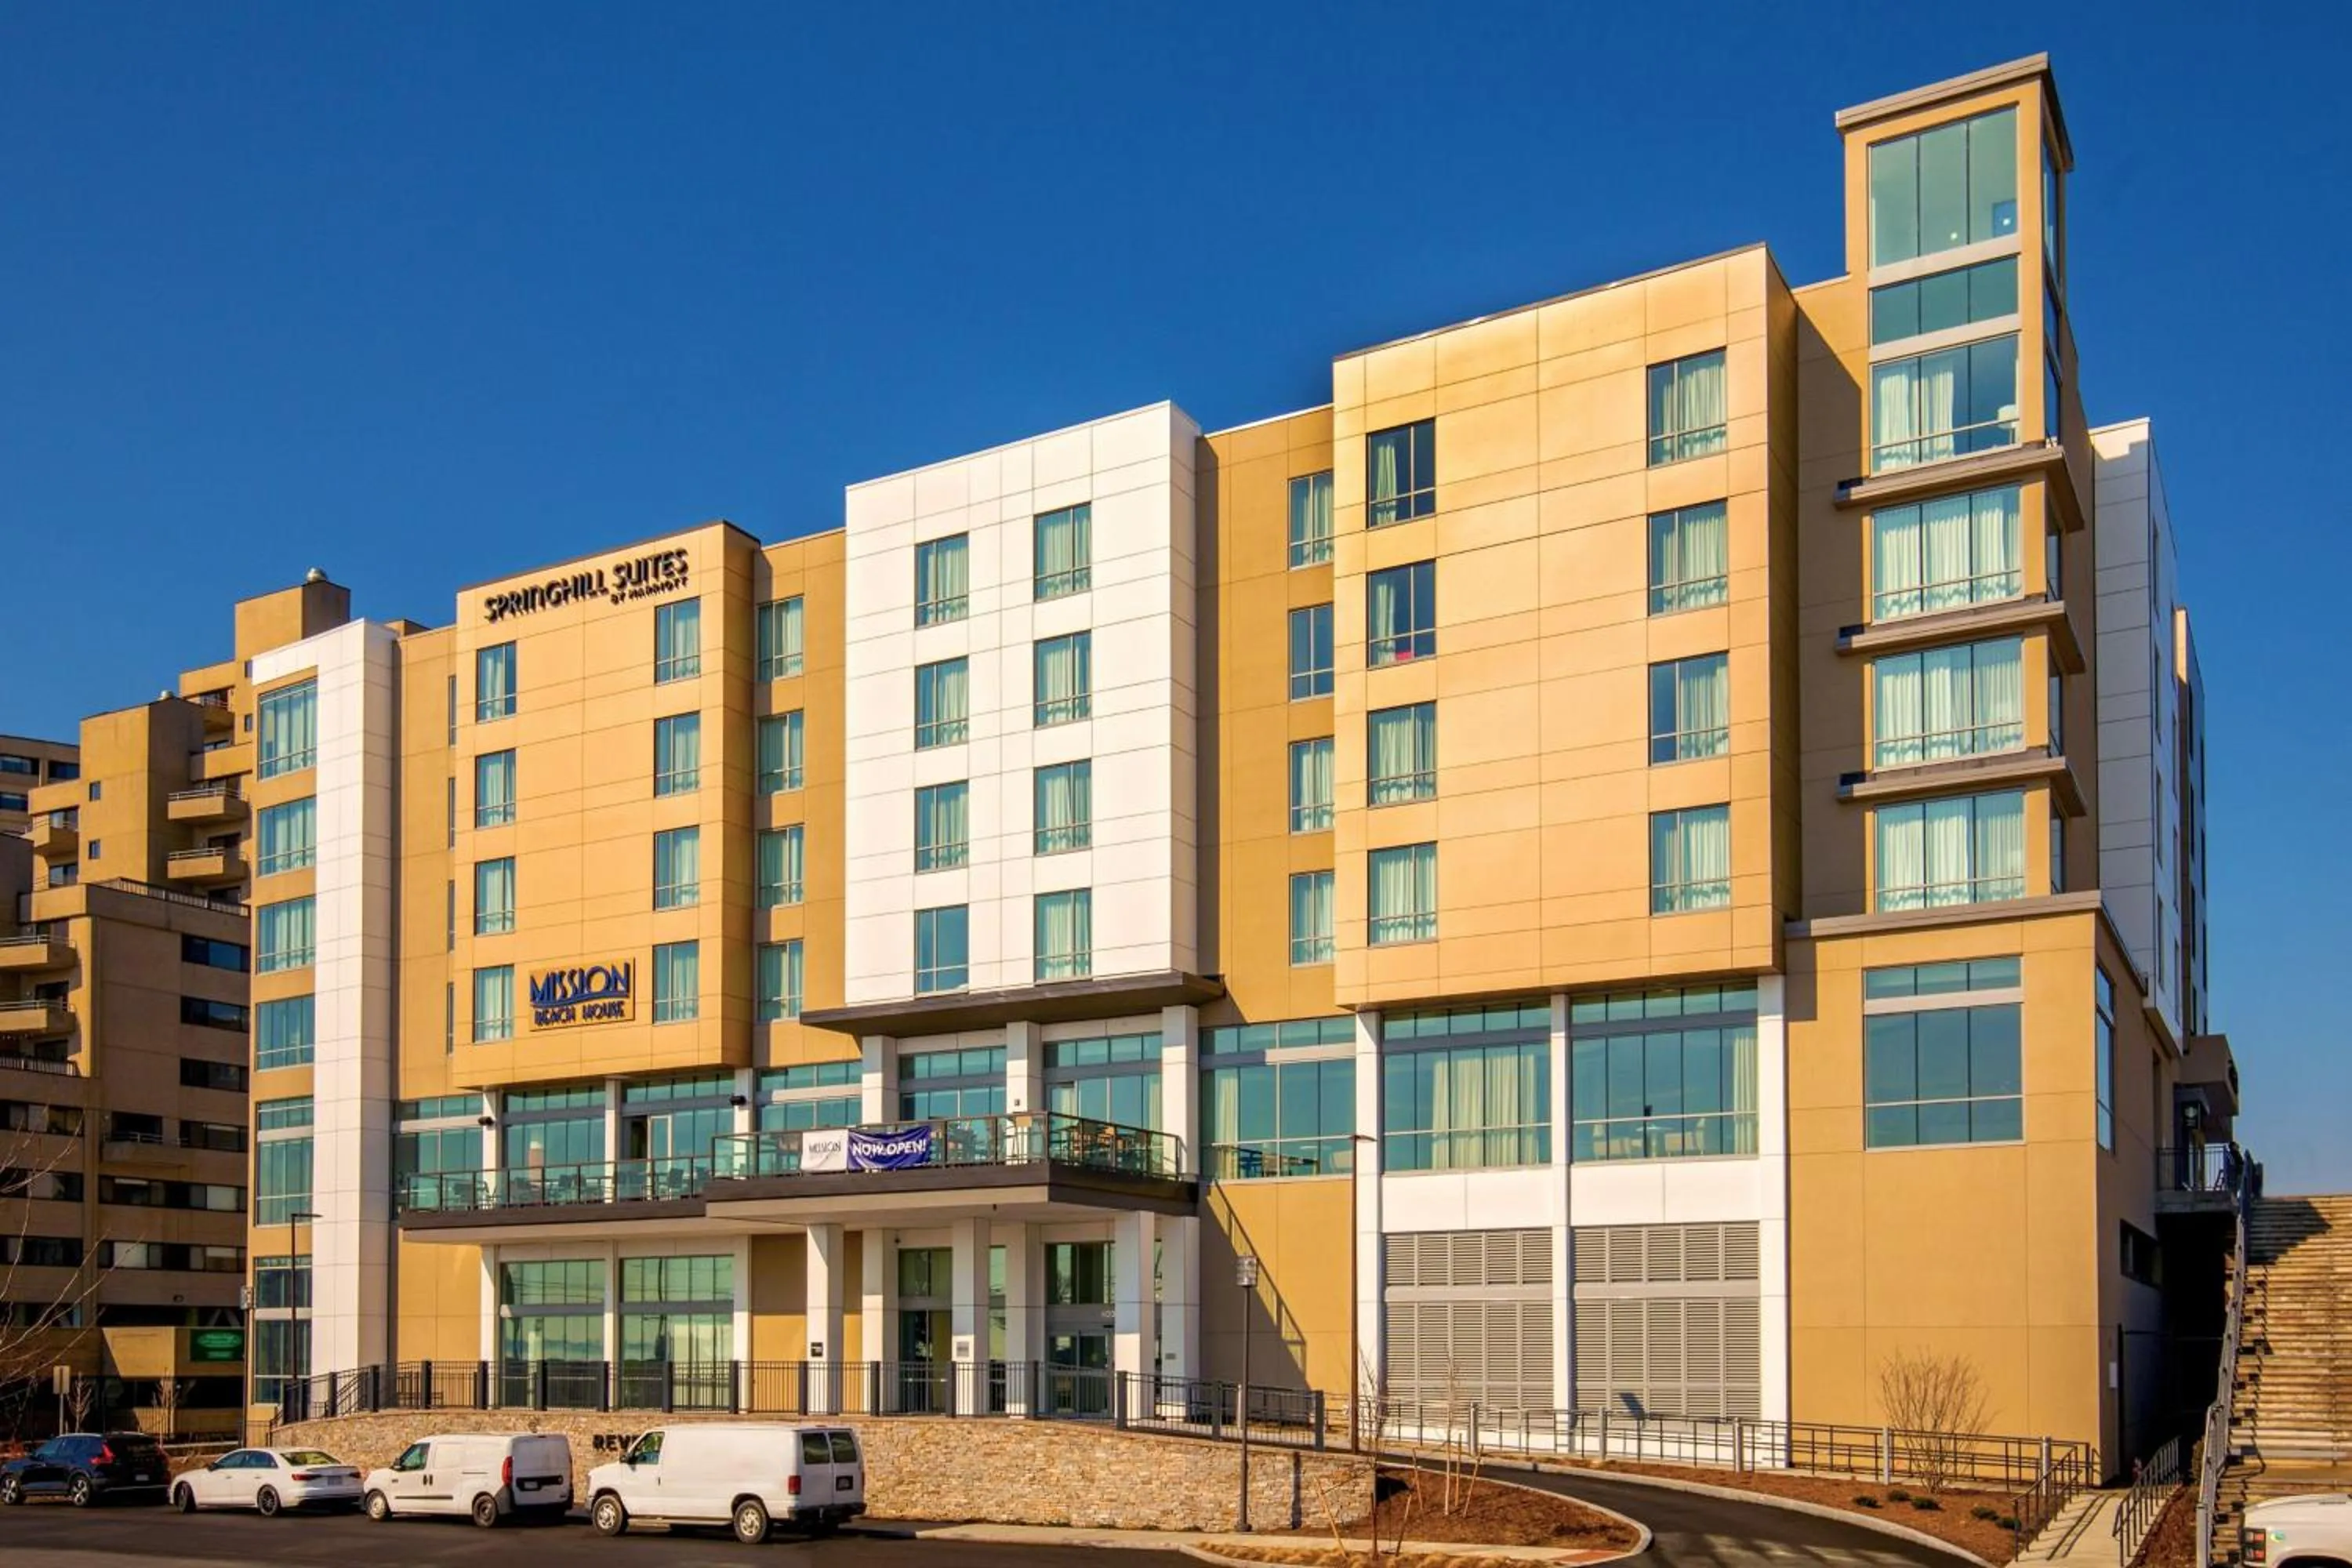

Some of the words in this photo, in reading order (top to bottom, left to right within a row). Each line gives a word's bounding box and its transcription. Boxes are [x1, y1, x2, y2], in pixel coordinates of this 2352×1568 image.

[484, 568, 608, 623] SPRINGHILL
[612, 547, 688, 589] SUITES
[629, 576, 688, 601] MARRIOTT
[530, 962, 630, 1003] MISSION
[583, 1000, 625, 1022] HOUSE
[852, 1142, 884, 1156] NOW
